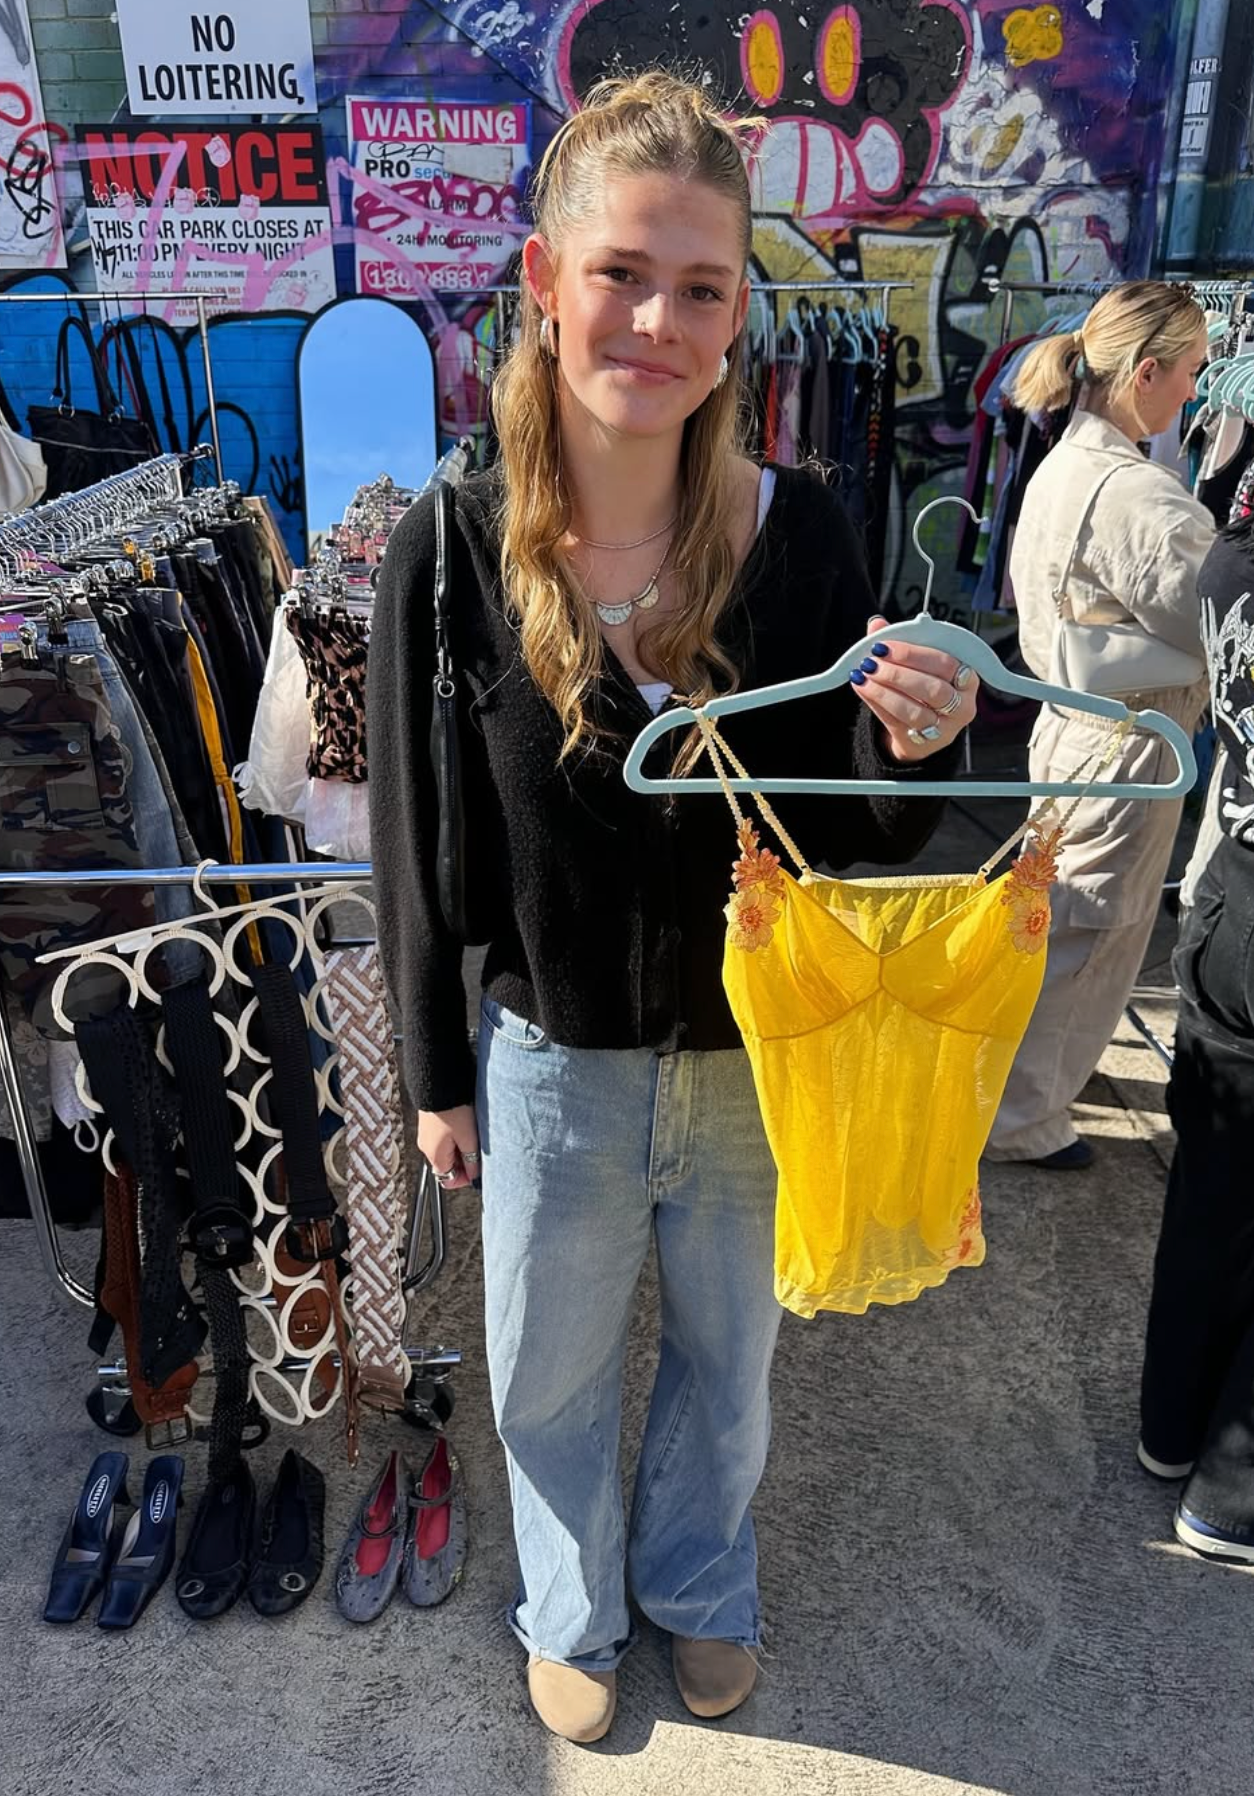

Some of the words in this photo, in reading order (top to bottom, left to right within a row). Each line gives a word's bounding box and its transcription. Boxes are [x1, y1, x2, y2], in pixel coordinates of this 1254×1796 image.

[191, 14, 235, 52] NO
[138, 63, 298, 101] LOITERING
[361, 107, 517, 141] WARNING
[85, 131, 318, 202] NOTICE
[365, 160, 410, 178] PRO
[93, 220, 133, 239] THIS
[181, 220, 228, 239] PARK
[232, 219, 299, 239] CLOSES
[304, 219, 324, 239] AT
[396, 234, 425, 247] 24H
